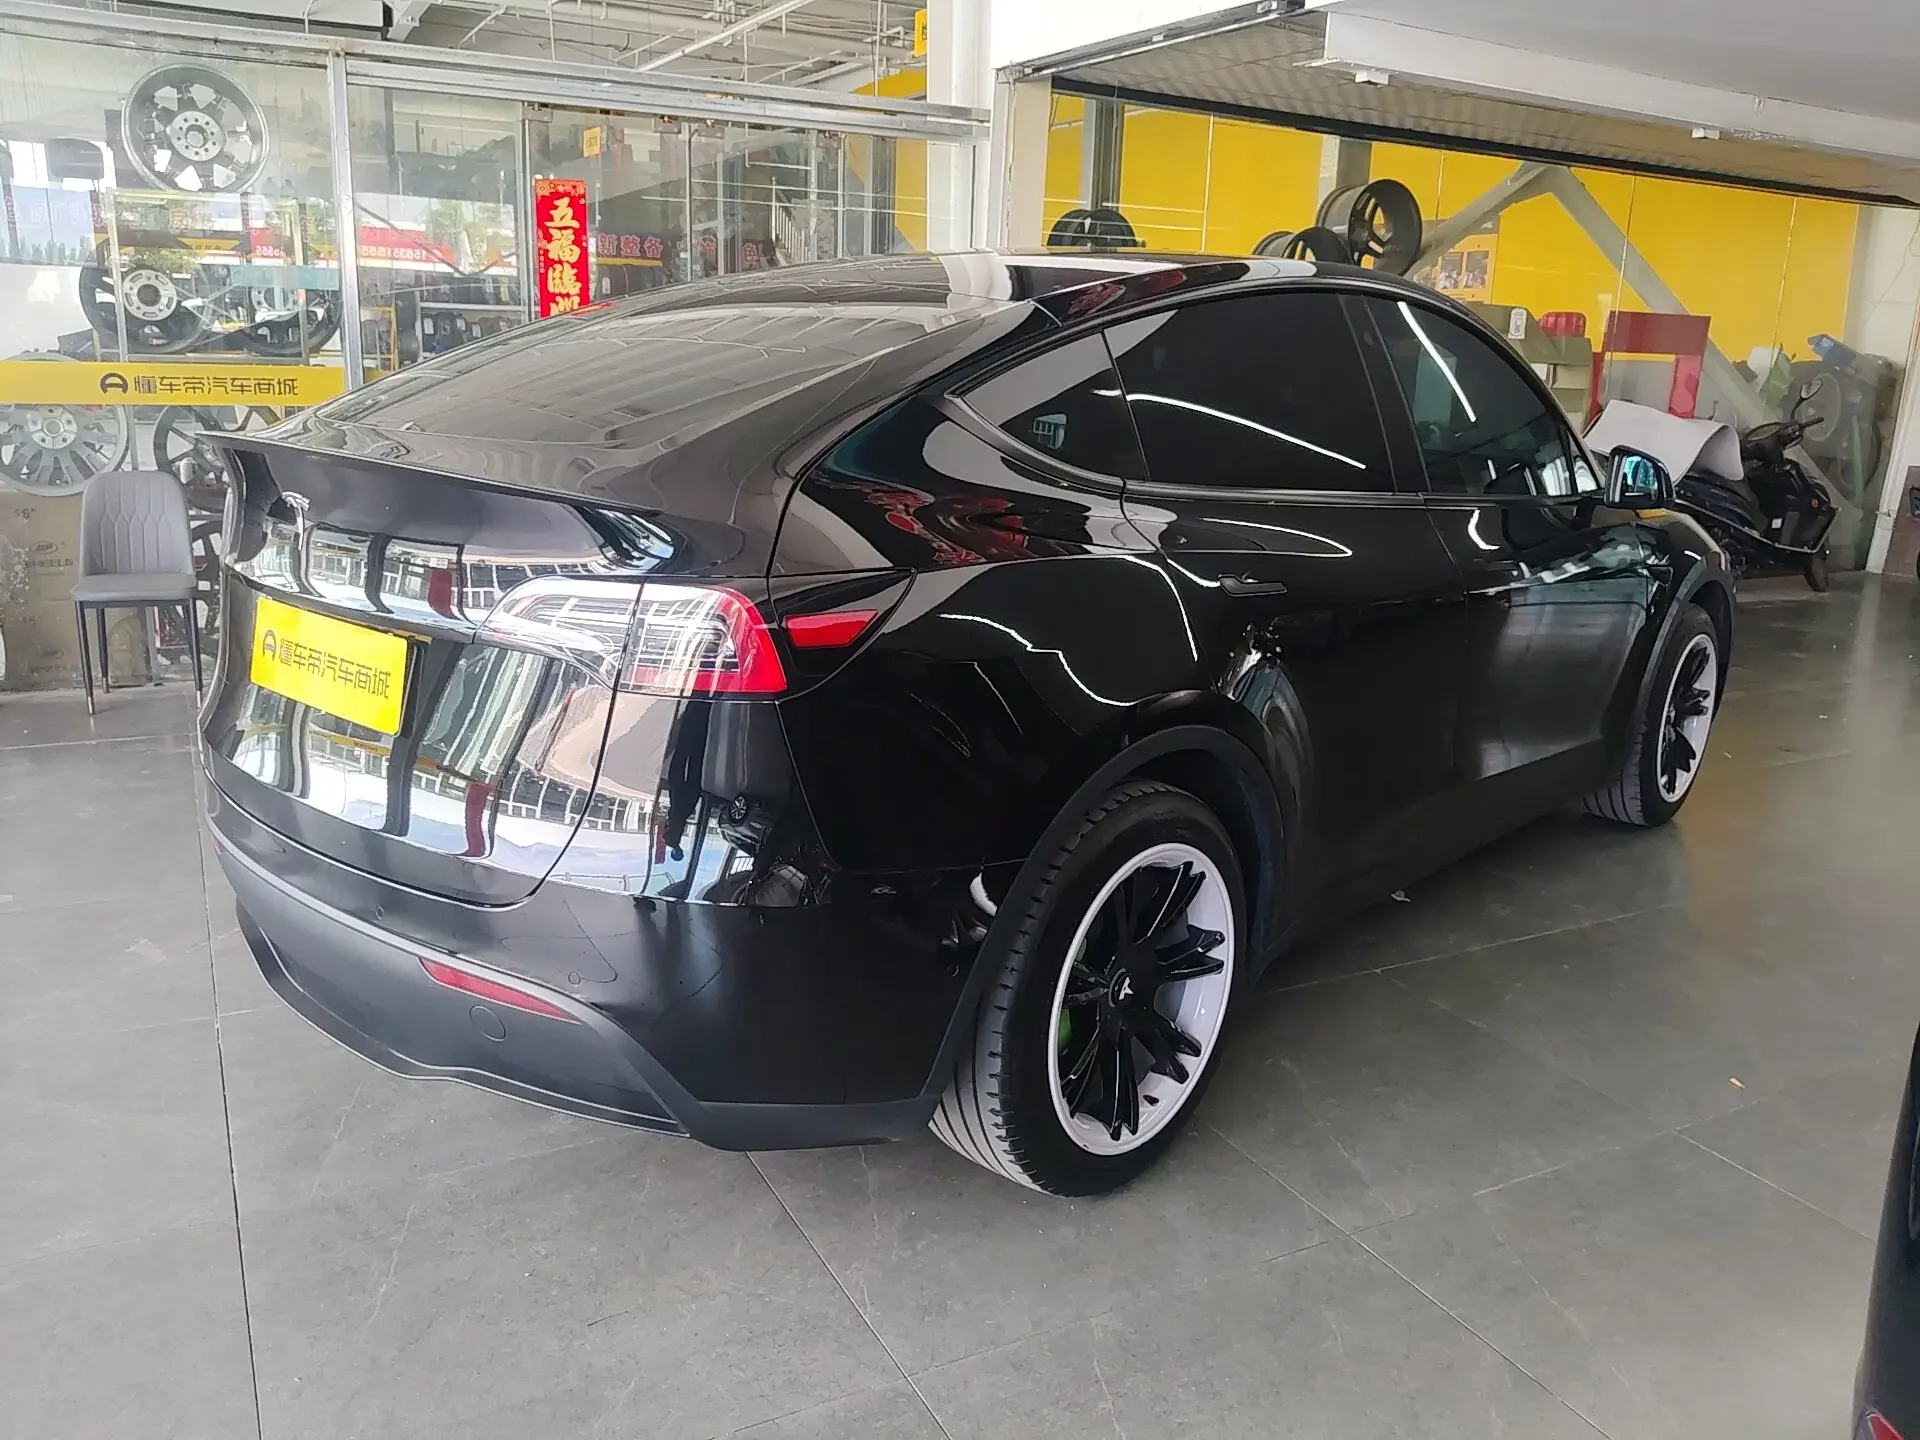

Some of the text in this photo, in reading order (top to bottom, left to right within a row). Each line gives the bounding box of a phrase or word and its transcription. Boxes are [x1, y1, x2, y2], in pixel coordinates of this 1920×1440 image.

[134, 375, 299, 396] 懂车帝汽车商城
[279, 637, 392, 700] 懂车帝汽车商城
